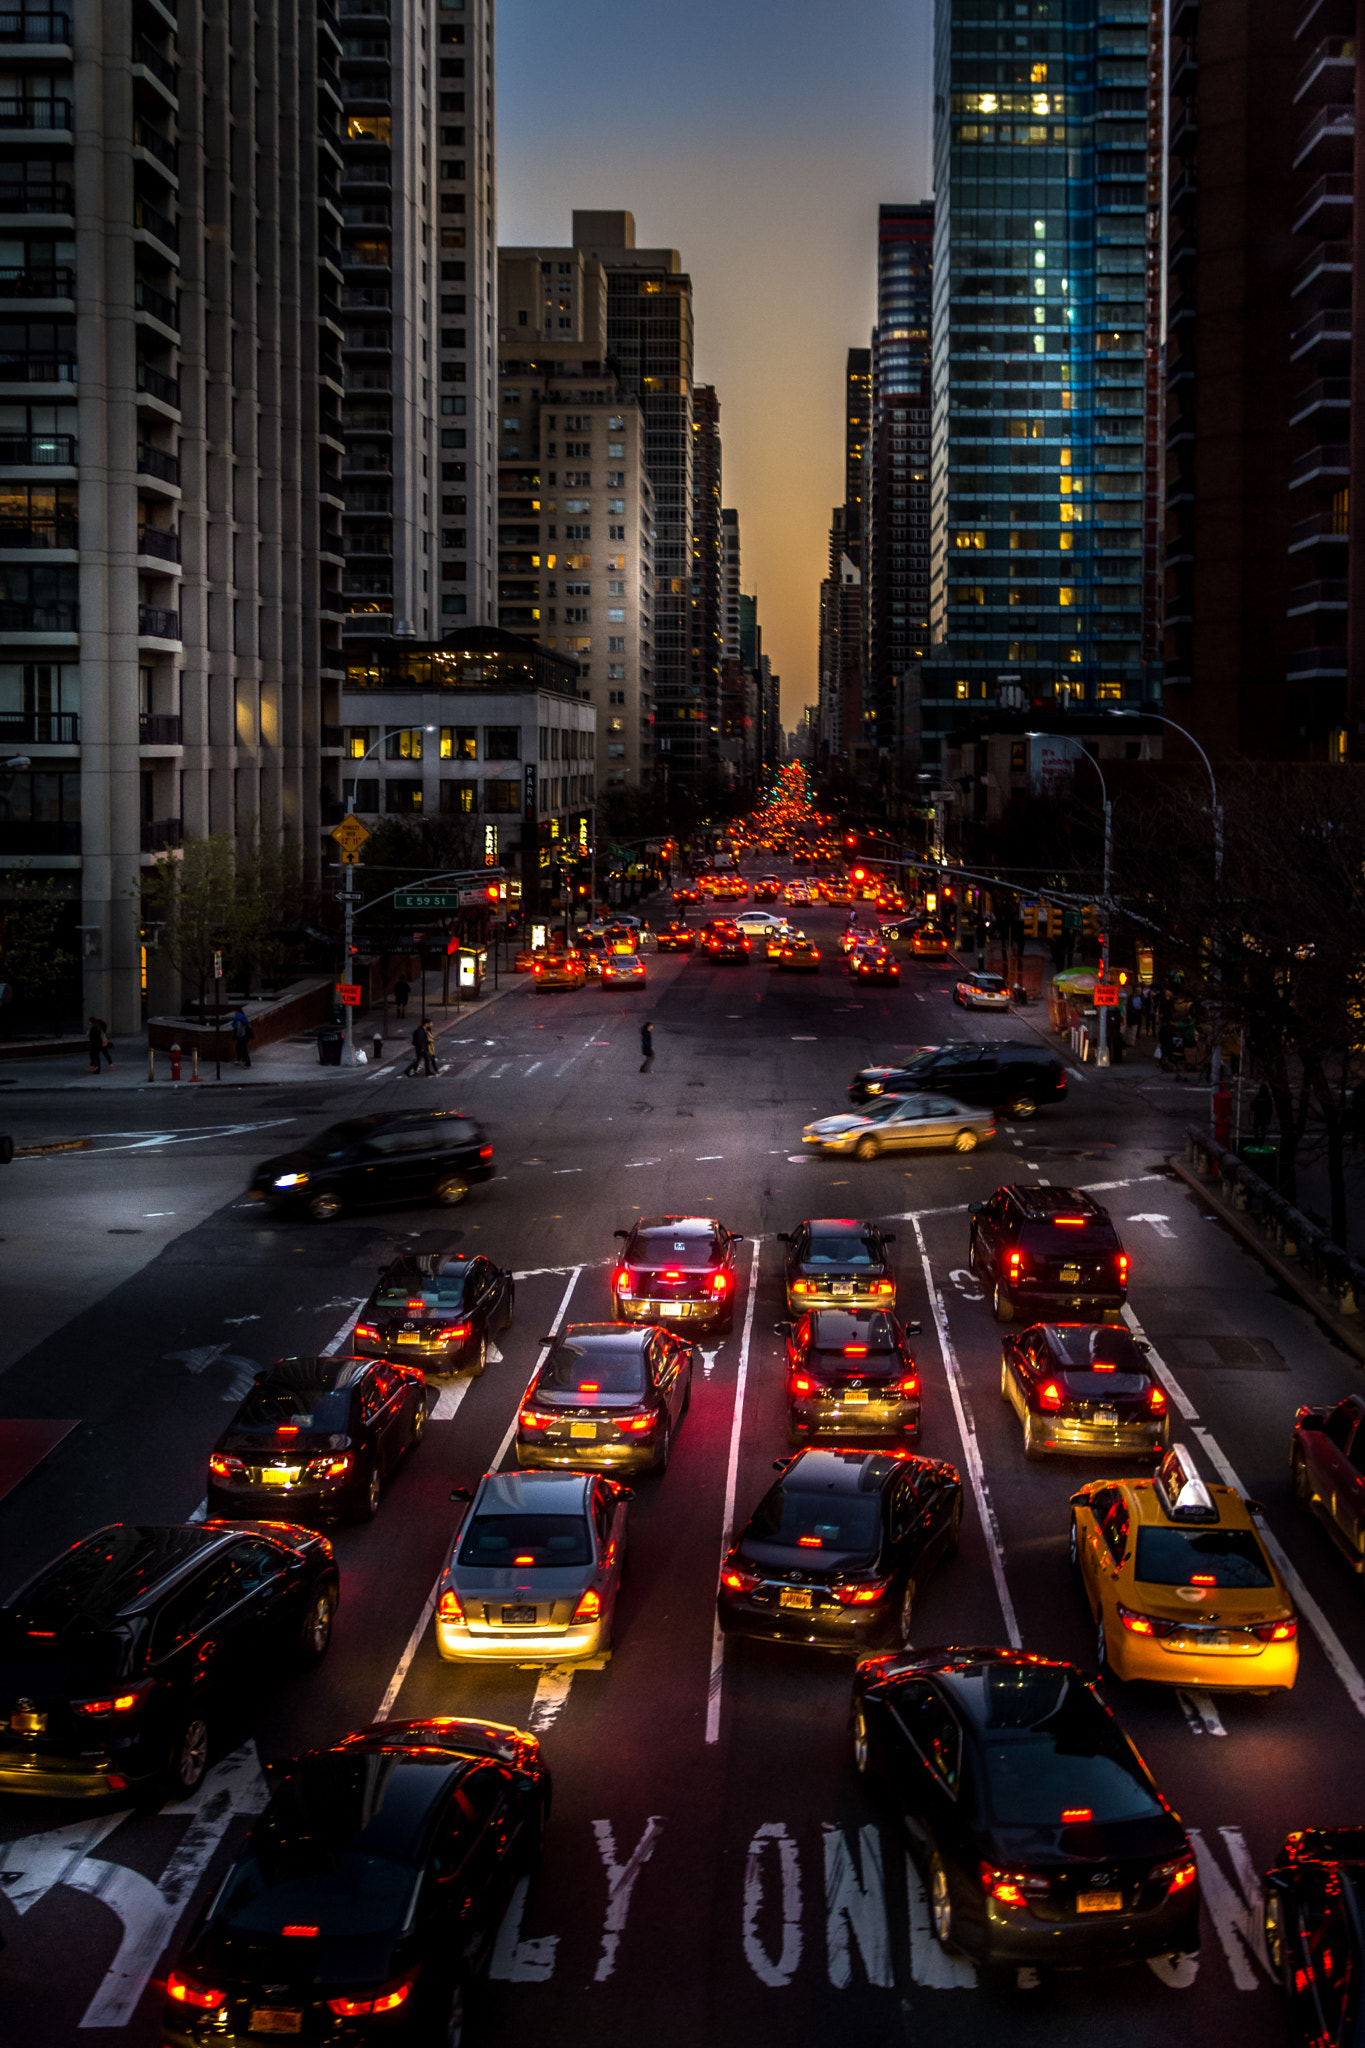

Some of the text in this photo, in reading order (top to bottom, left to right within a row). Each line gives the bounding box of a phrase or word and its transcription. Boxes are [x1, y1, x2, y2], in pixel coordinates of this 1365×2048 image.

[485, 824, 494, 855] PARK
[579, 817, 588, 846] PARK
[406, 896, 446, 905] E 59 St
